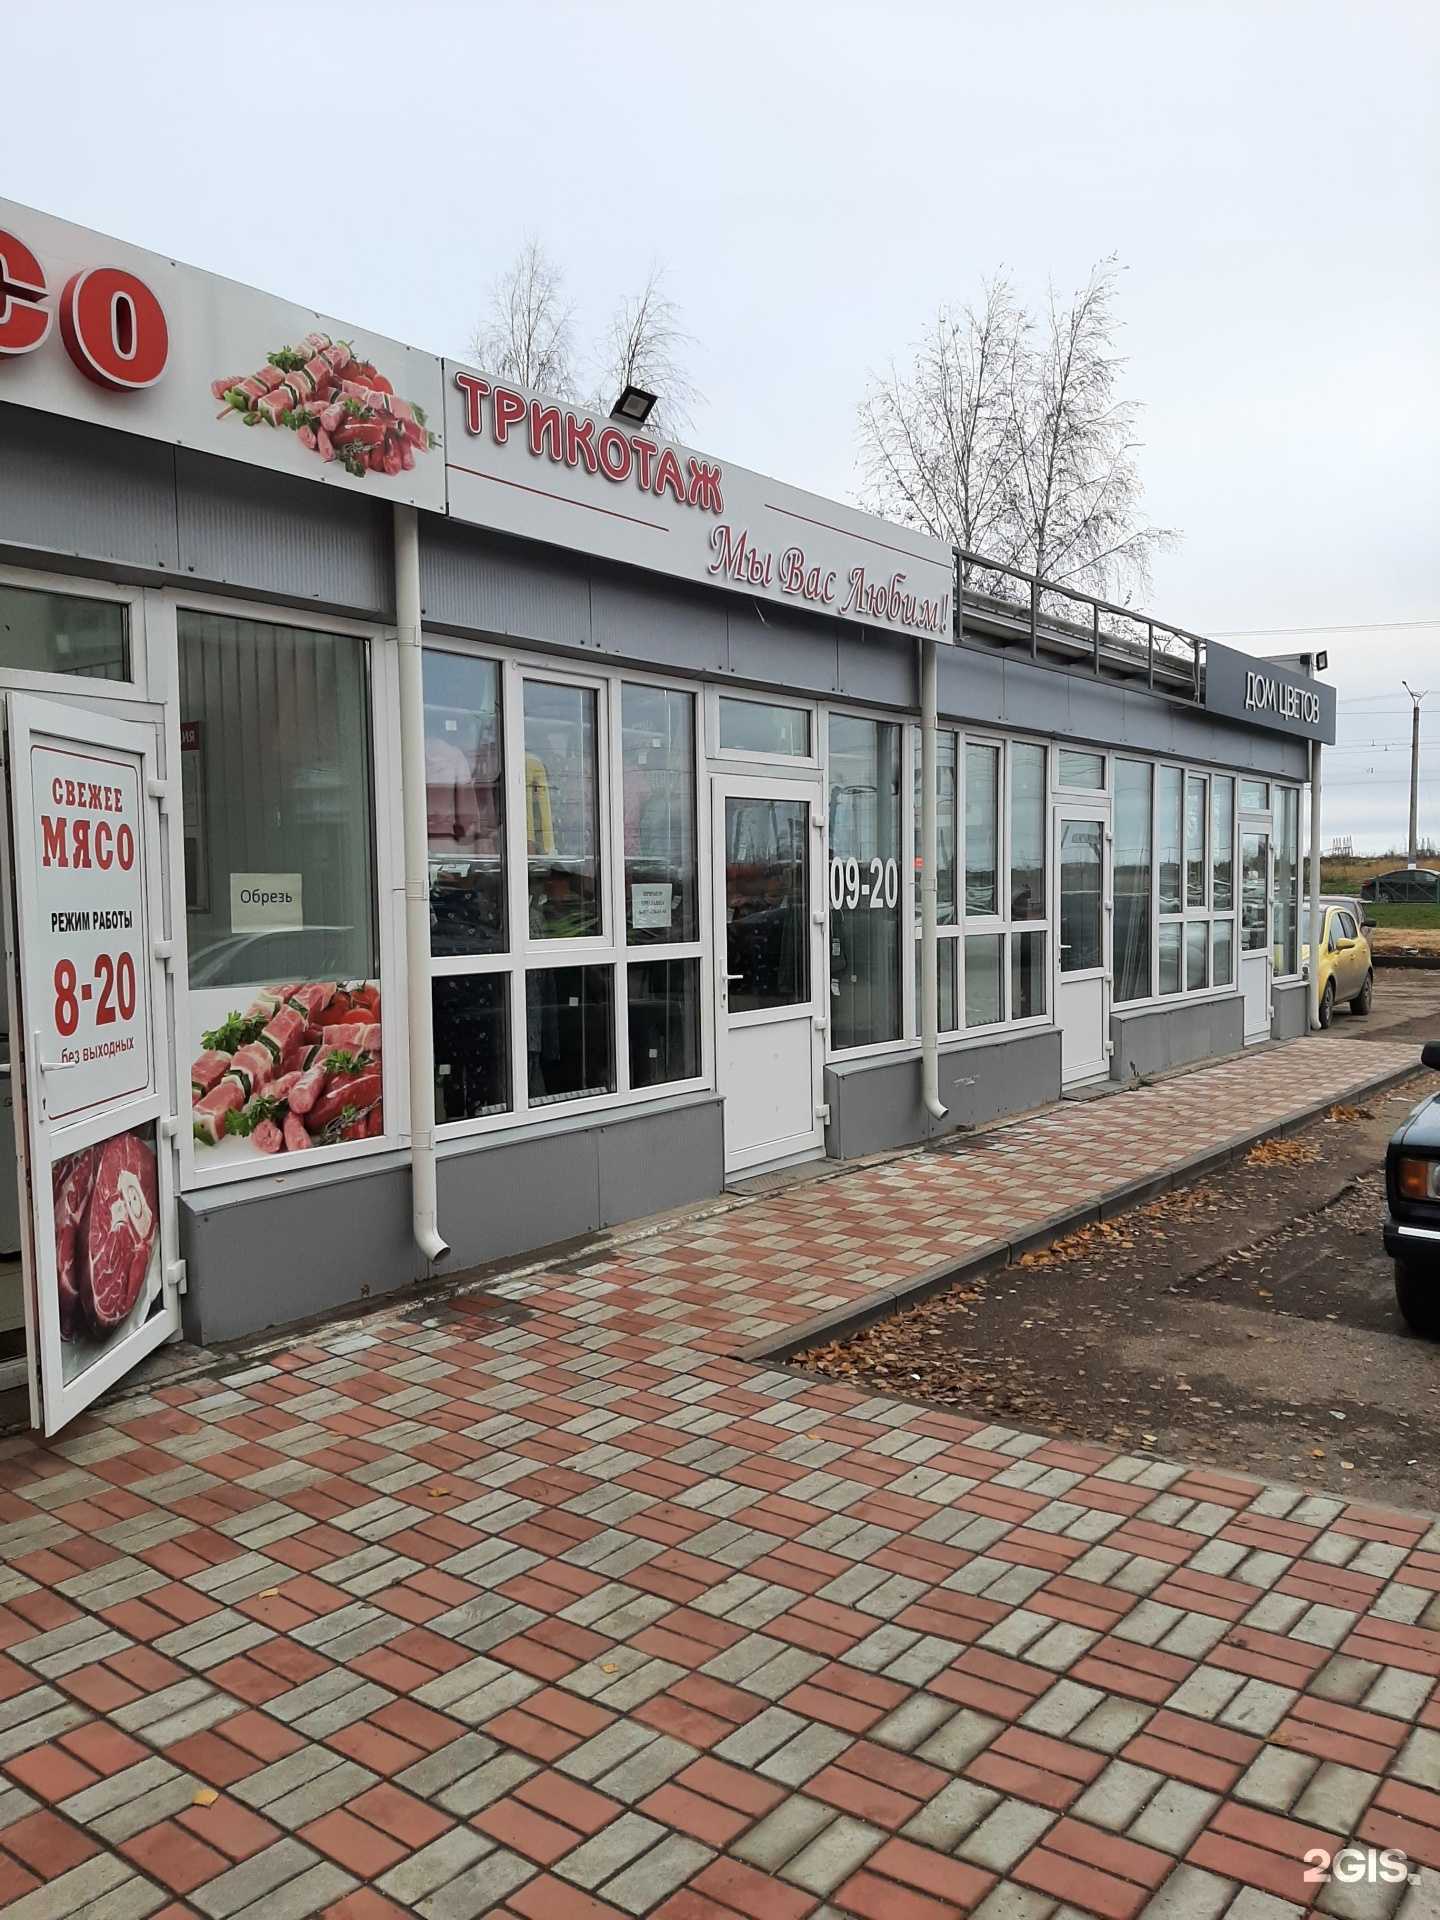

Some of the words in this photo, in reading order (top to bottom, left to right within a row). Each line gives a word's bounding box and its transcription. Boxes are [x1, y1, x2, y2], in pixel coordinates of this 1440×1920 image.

[456, 372, 725, 514] ТРИКОТАЖ
[709, 525, 774, 588] Мы
[780, 547, 837, 603] Вас
[839, 567, 948, 633] Любим!
[1245, 671, 1276, 712] ДОМ
[1278, 683, 1320, 724] ЦВЕТОВ
[52, 777, 123, 812] СВЕЖЕЕ
[41, 815, 135, 871] МЯСО
[240, 889, 293, 905] Обрезь
[830, 857, 898, 909] 09-20
[51, 912, 90, 933] РЕЖИМ
[93, 910, 133, 930] РАБОТЫ
[54, 951, 136, 1037] 8-20
[61, 1047, 80, 1064] без
[83, 1037, 134, 1062] выходных
